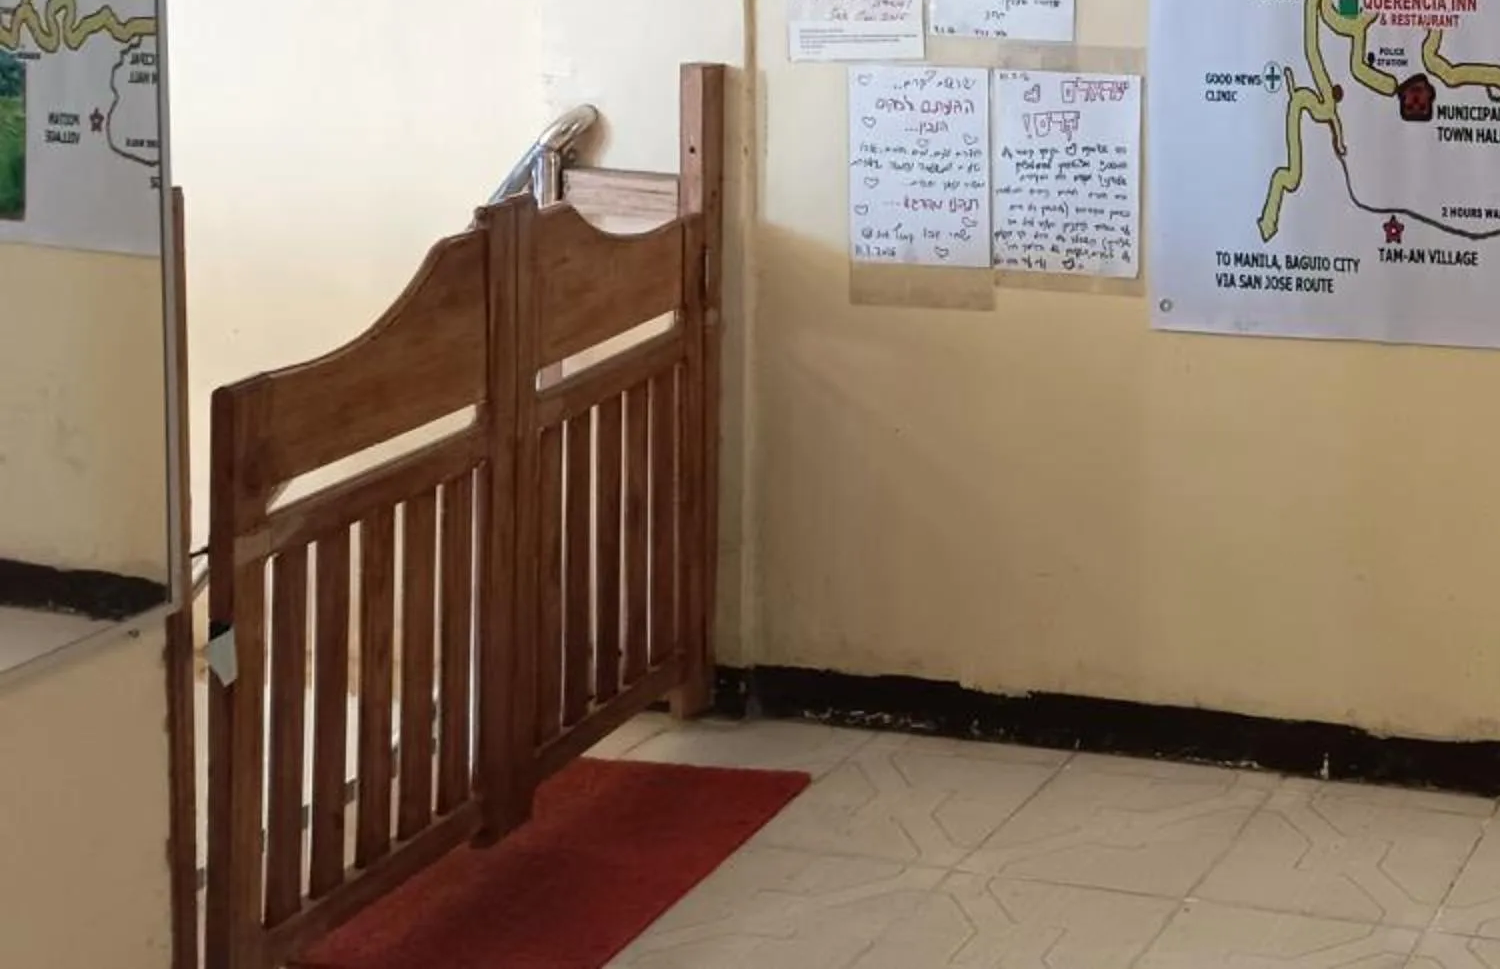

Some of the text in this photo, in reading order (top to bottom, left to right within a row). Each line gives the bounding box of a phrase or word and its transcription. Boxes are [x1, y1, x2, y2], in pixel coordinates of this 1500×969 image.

[1379, 14, 1460, 27] & RESTAURANT
[1205, 73, 1262, 86] GOOD NEWS
[1205, 90, 1238, 103] CLINIC
[1437, 126, 1474, 143] TOWN
[1449, 207, 1483, 219] HOURS
[1216, 251, 1361, 273] TO MANILA, BAGUIO CITY
[1378, 247, 1478, 266] TAM-AN VILLAGE
[1216, 273, 1334, 293] VIA SAN JOSE ROUTE
